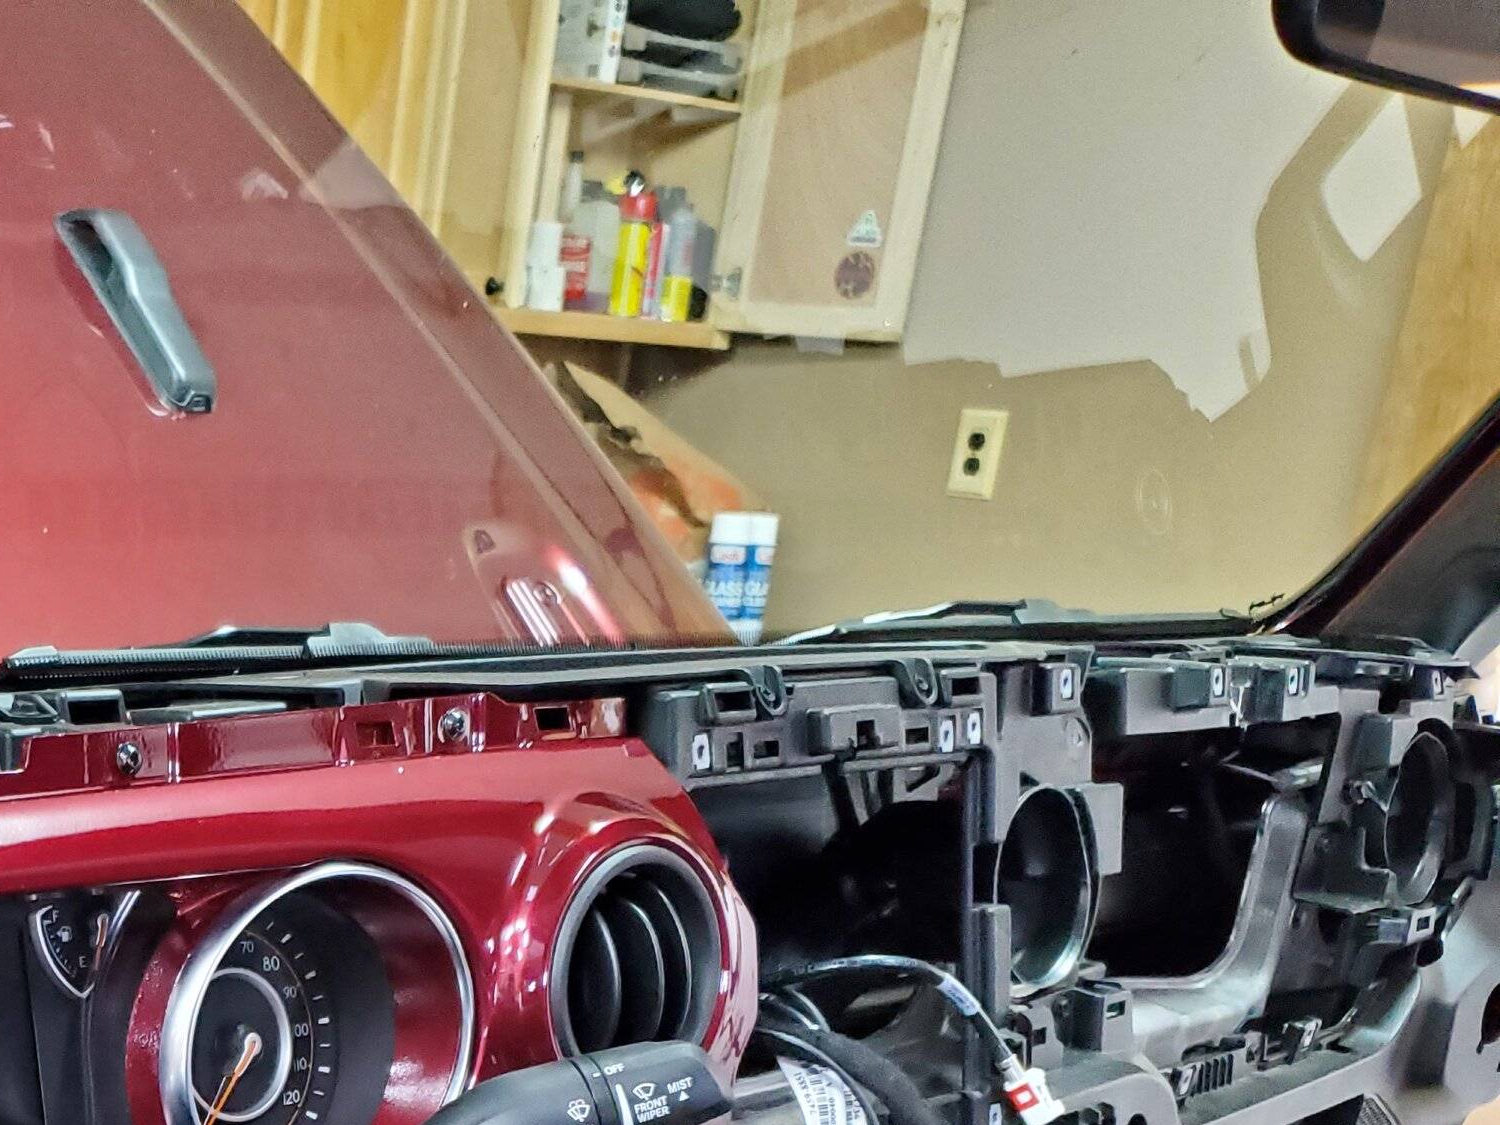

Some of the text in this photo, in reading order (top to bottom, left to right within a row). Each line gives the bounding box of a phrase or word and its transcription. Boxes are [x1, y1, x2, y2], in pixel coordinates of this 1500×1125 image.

[240, 941, 254, 954] 70
[262, 955, 280, 971] 80
[283, 986, 297, 999] 90
[294, 1023, 309, 1037] 00
[604, 1062, 625, 1076] OFF
[667, 1077, 693, 1094] MIST
[283, 1089, 300, 1105] 120
[634, 1095, 668, 1113] FRONT
[636, 1105, 670, 1124] WIPER
